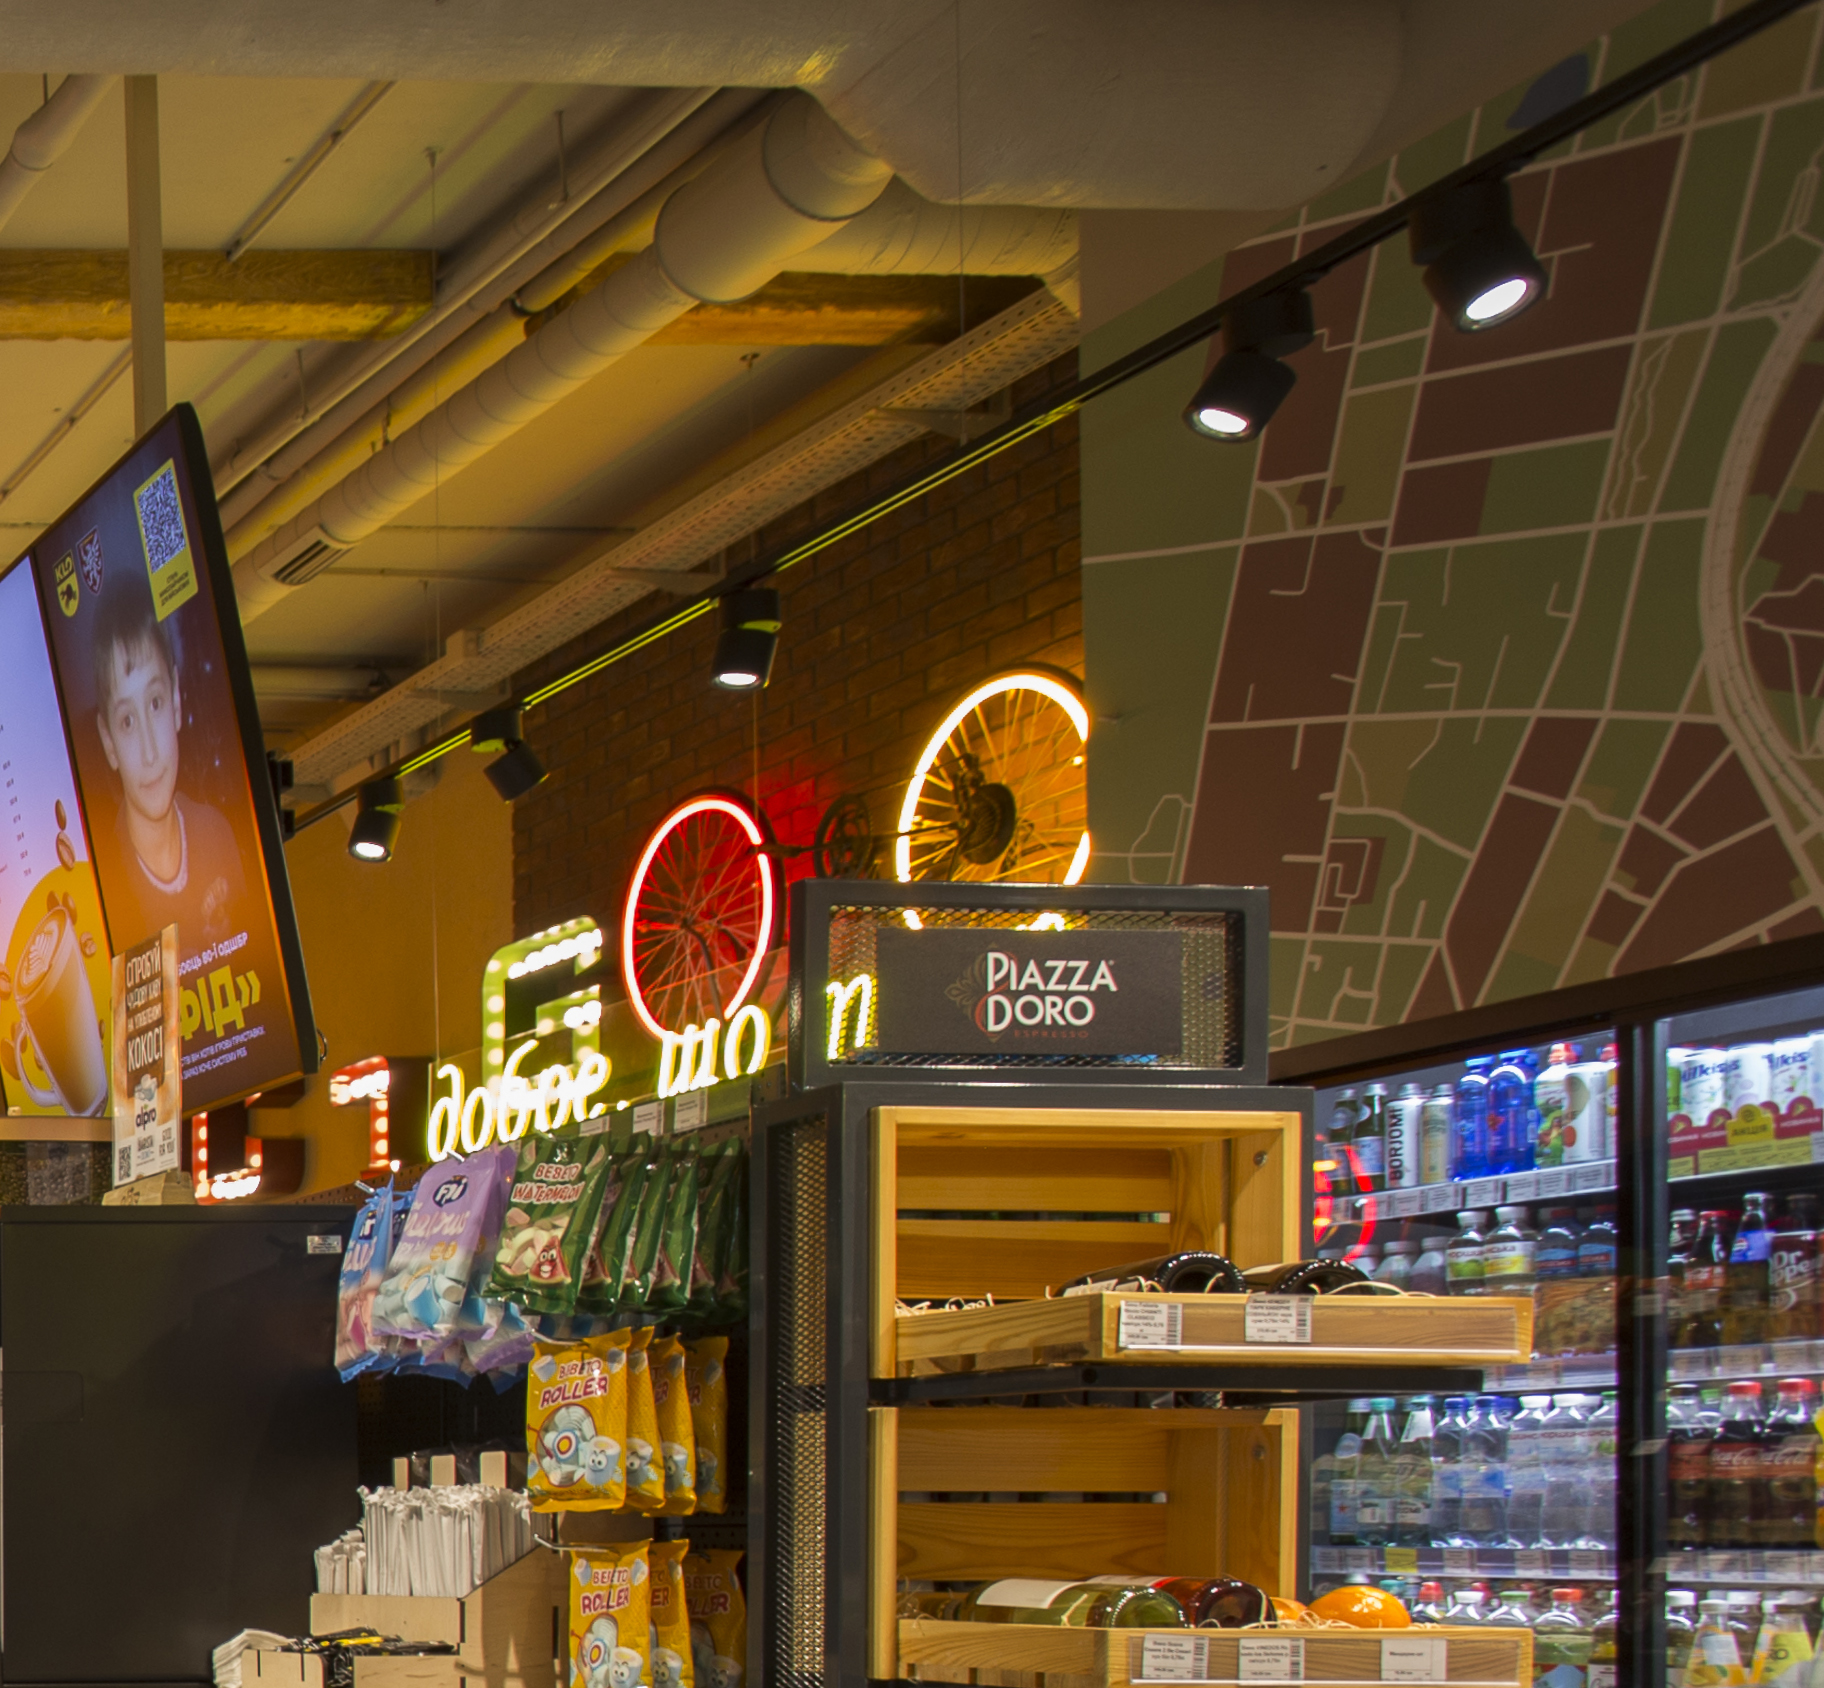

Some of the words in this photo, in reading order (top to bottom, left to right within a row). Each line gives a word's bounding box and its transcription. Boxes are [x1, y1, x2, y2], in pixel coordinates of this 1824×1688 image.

[55, 555, 74, 584] KLO
[126, 940, 161, 988] СПРОБУЙ
[987, 952, 1119, 992] PIAZZA
[987, 995, 1095, 1032] DORO
[128, 1025, 163, 1072] КОКОСІ
[135, 1106, 157, 1131] alpro
[1389, 1107, 1404, 1182] BORJOMI
[534, 1163, 581, 1181] BEBETO
[511, 1182, 586, 1204] WATERMELON
[540, 1376, 609, 1410] ROLLER
[581, 1586, 631, 1616] ROLLER
